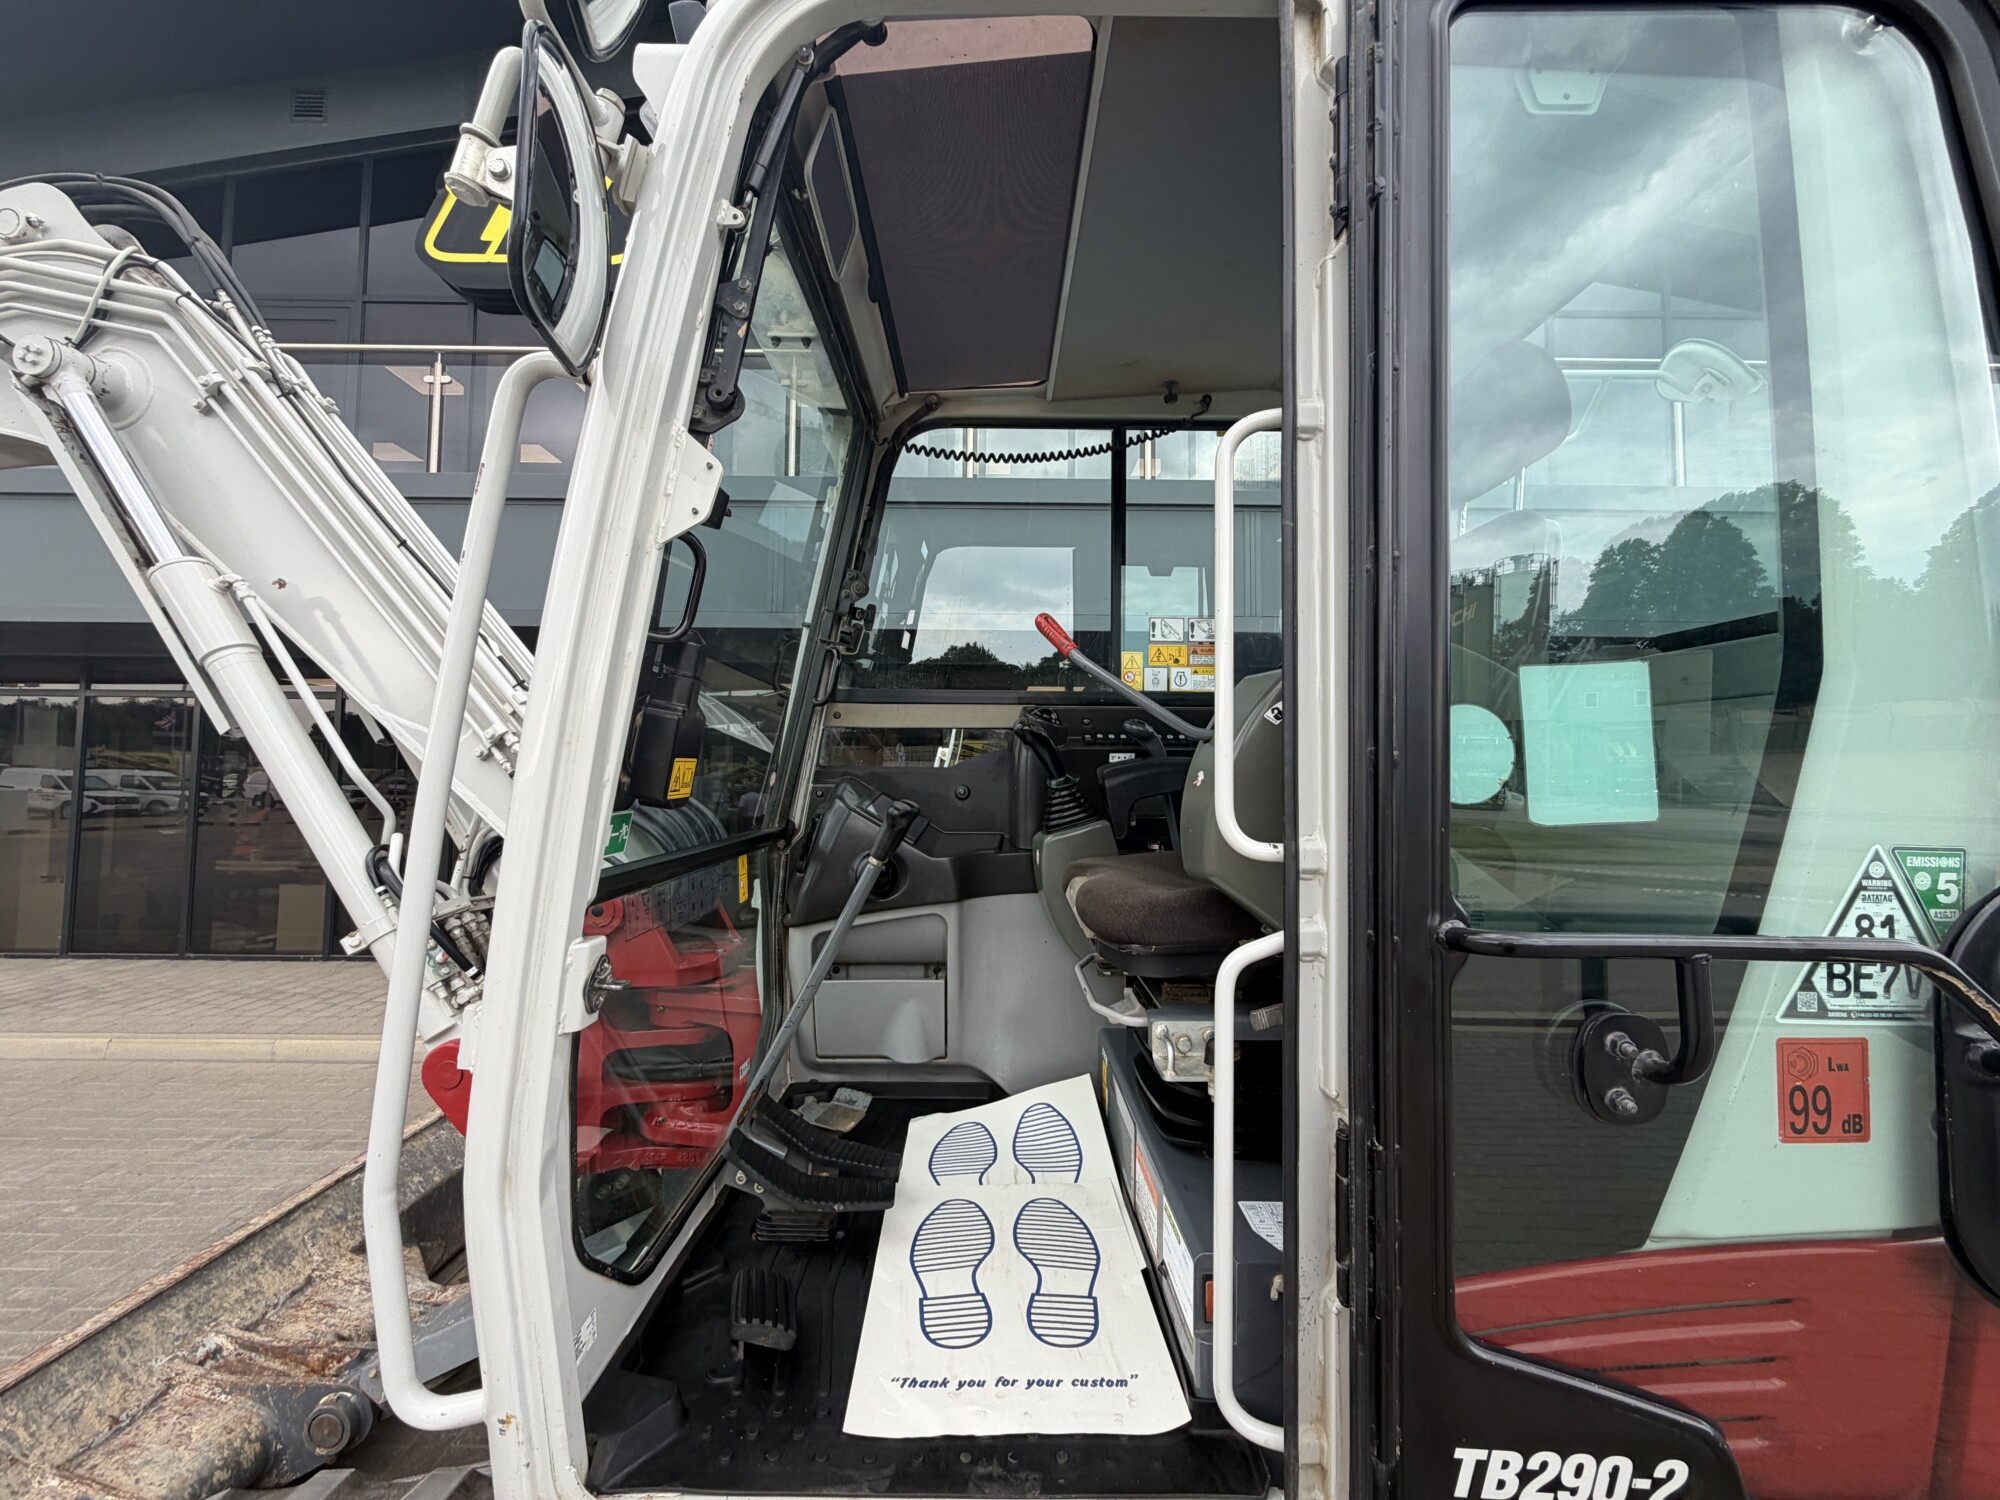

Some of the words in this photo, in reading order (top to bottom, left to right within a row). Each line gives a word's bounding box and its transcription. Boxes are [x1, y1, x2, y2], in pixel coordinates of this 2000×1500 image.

[1906, 856, 1960, 868] EMISSIONS
[1862, 879, 1893, 887] WARNING
[1936, 872, 1959, 904] 5
[1861, 894, 1893, 903] DATATAG
[1855, 914, 1895, 938] 81
[1789, 1085, 1832, 1135] 99
[1842, 1113, 1863, 1134] dB
[956, 1379, 986, 1391] you
[995, 1376, 1019, 1388] for
[1025, 1378, 1063, 1390] your
[1453, 1448, 1689, 1500] TB290-2
